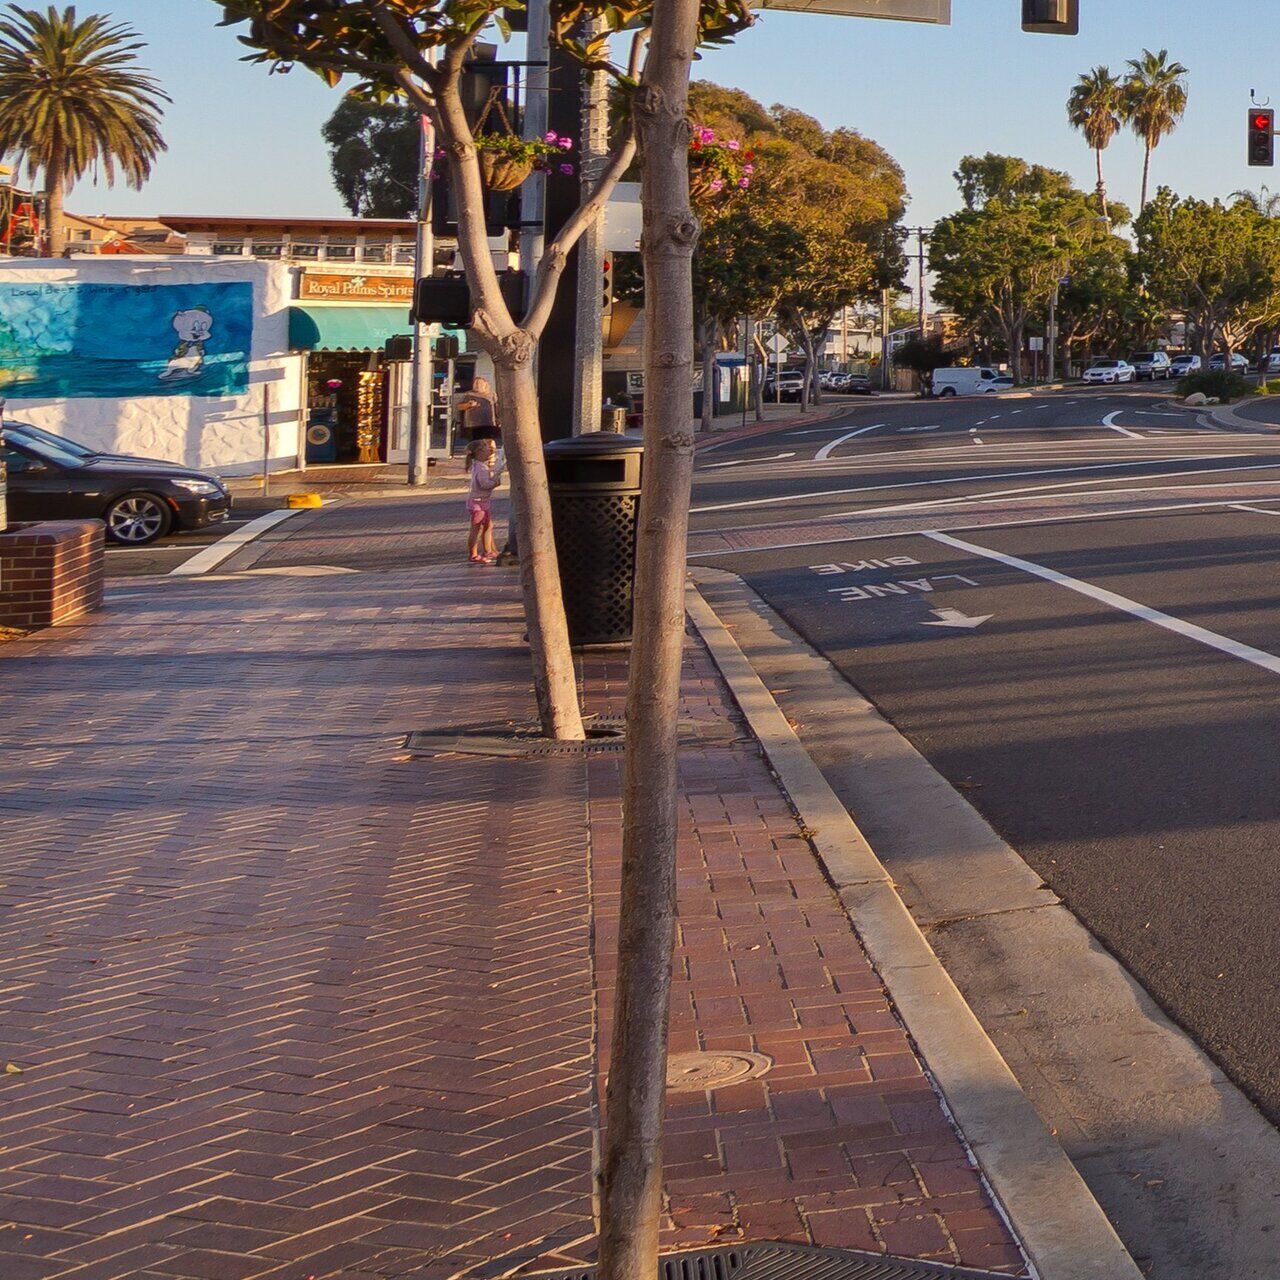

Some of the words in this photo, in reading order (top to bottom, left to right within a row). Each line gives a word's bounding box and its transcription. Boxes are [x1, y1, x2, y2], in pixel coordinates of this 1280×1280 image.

[309, 281, 340, 297] Royal
[342, 281, 378, 296] Palms
[377, 283, 414, 299] Spirits
[809, 556, 922, 576] BIKE
[827, 574, 981, 602] LANE
